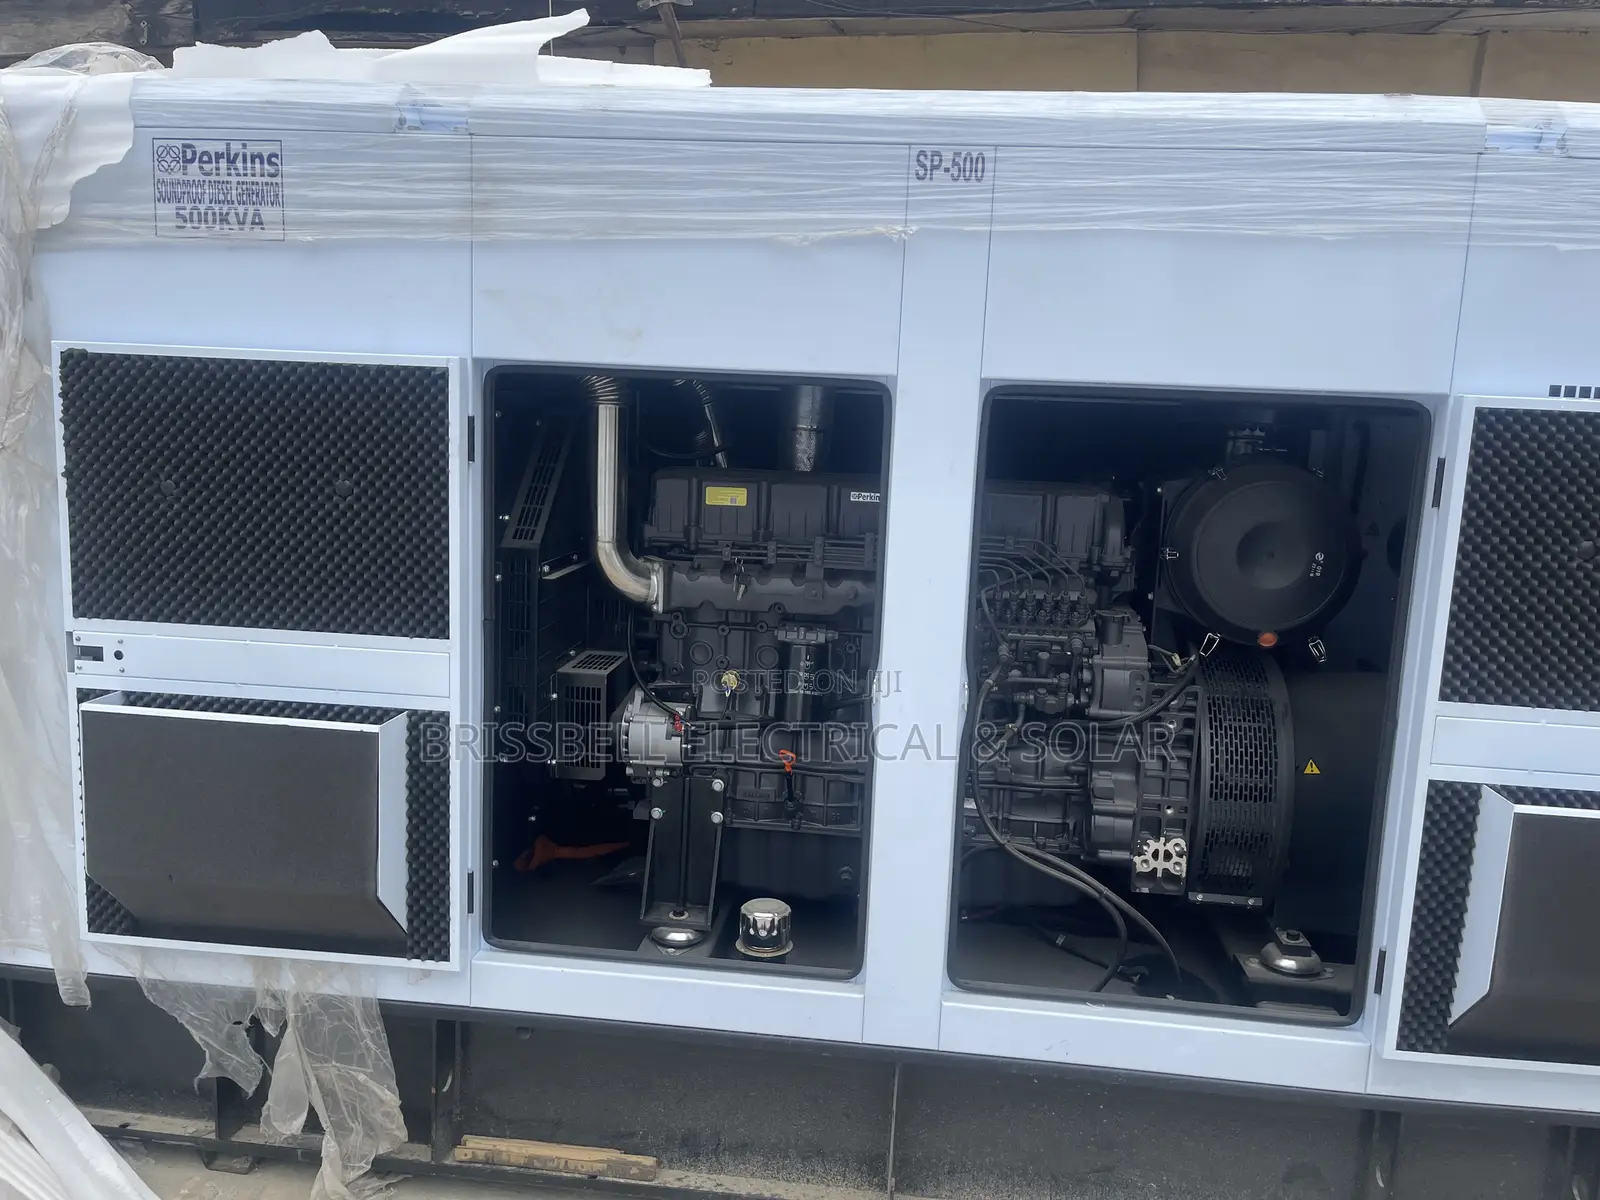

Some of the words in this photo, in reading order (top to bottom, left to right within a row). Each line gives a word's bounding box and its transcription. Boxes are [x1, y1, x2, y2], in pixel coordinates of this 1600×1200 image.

[181, 142, 280, 177] Perkins
[915, 150, 985, 182] SP-500
[156, 178, 206, 204] SOUNDPROOF
[208, 180, 235, 205] DIESEL
[236, 181, 281, 207] GENERATOR
[175, 205, 265, 230] 500KVA
